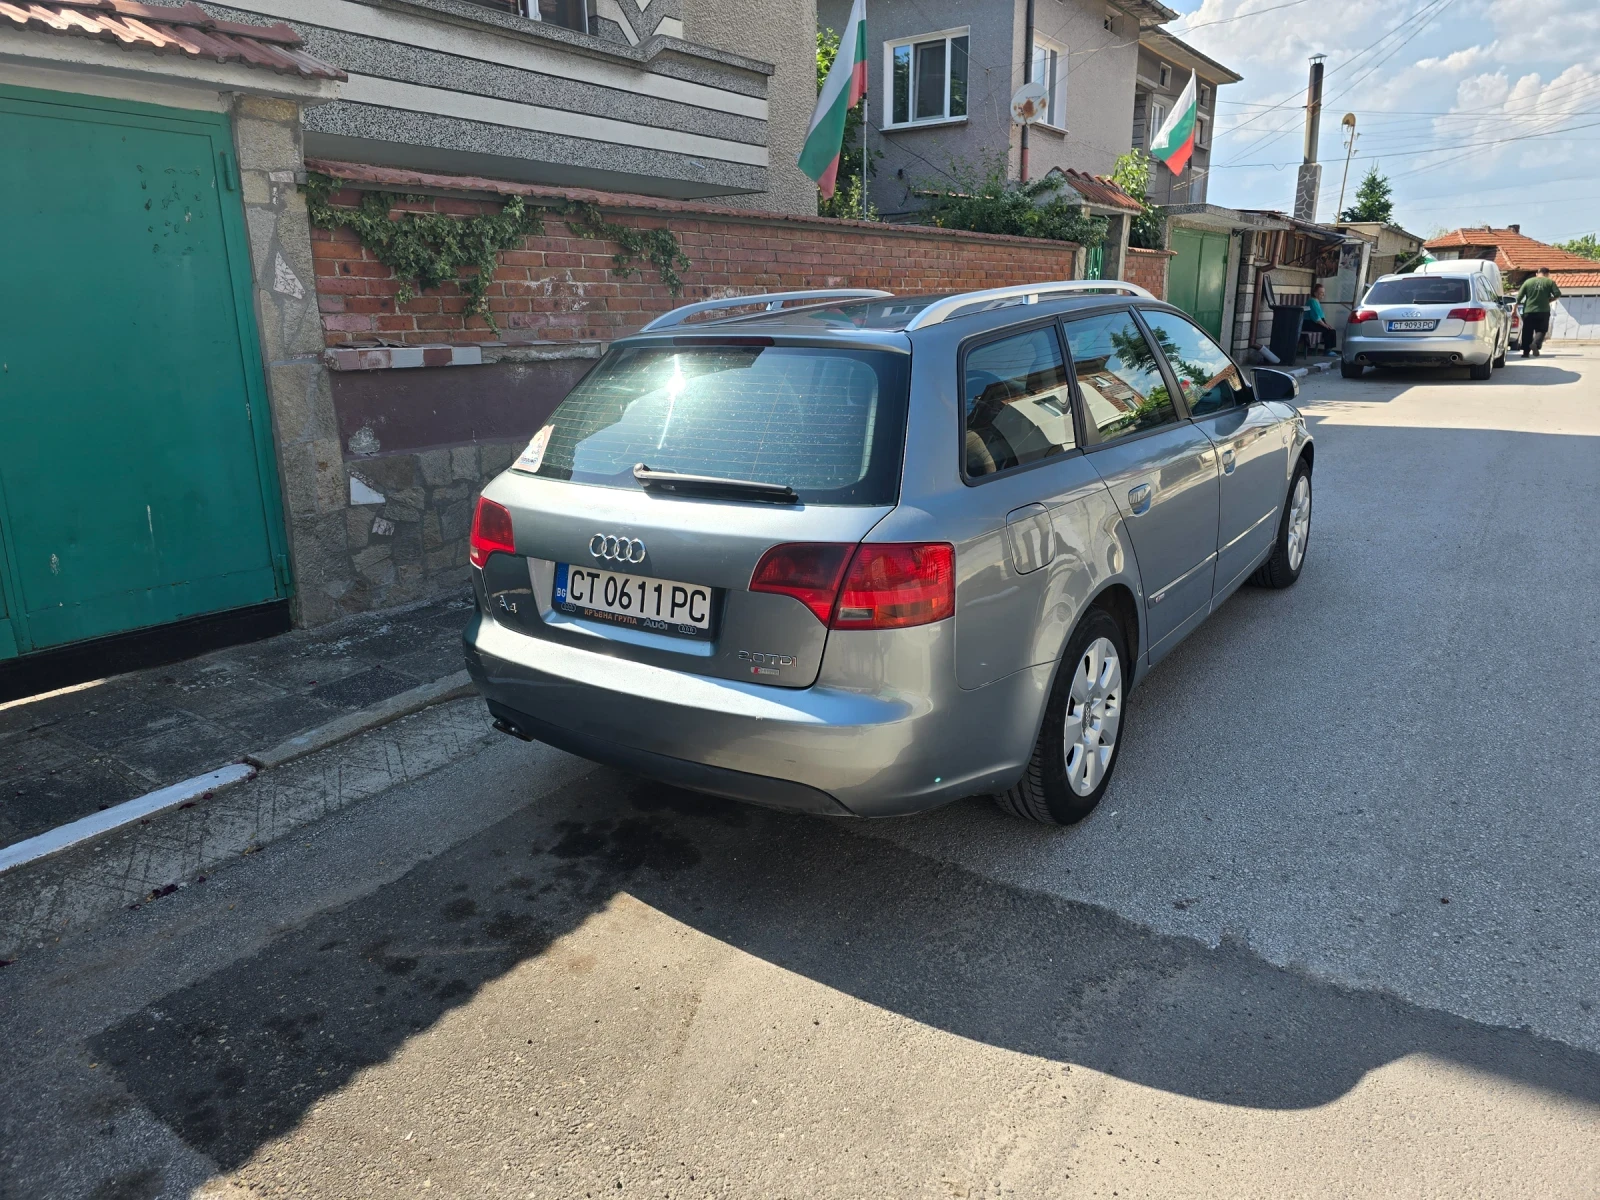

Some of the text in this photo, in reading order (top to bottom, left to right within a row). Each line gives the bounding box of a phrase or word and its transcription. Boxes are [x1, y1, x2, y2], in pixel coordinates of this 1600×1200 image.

[1404, 321, 1422, 329] 9093
[556, 588, 566, 598] BG
[570, 570, 707, 623] CT 0611 PC
[500, 595, 517, 614] A4
[584, 608, 638, 625] КРЪВНА ГРУПА
[643, 617, 668, 631] Audi
